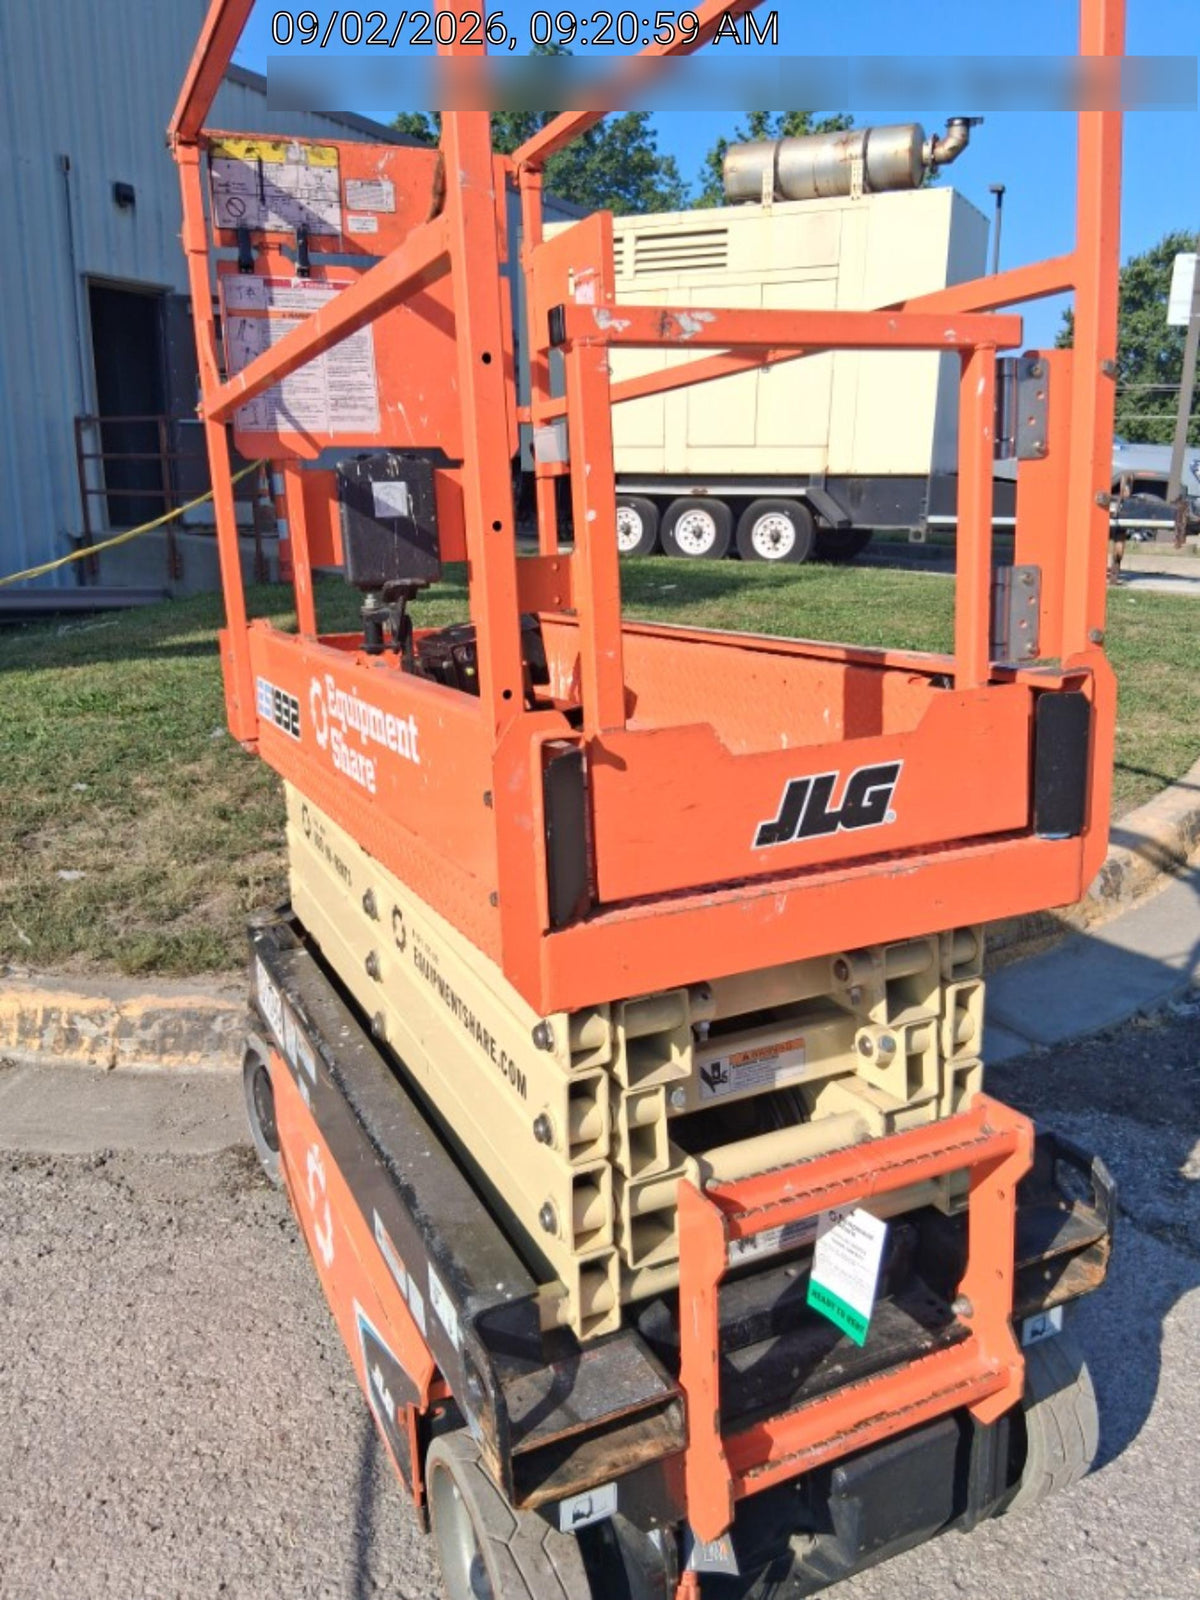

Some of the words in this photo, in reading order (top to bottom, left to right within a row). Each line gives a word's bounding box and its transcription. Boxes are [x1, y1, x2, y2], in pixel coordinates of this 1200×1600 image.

[324, 673, 420, 765] Equipment
[330, 725, 376, 795] Share
[751, 759, 904, 850] JLG
[413, 945, 527, 1101] EQUIPMENTSHARE.COM
